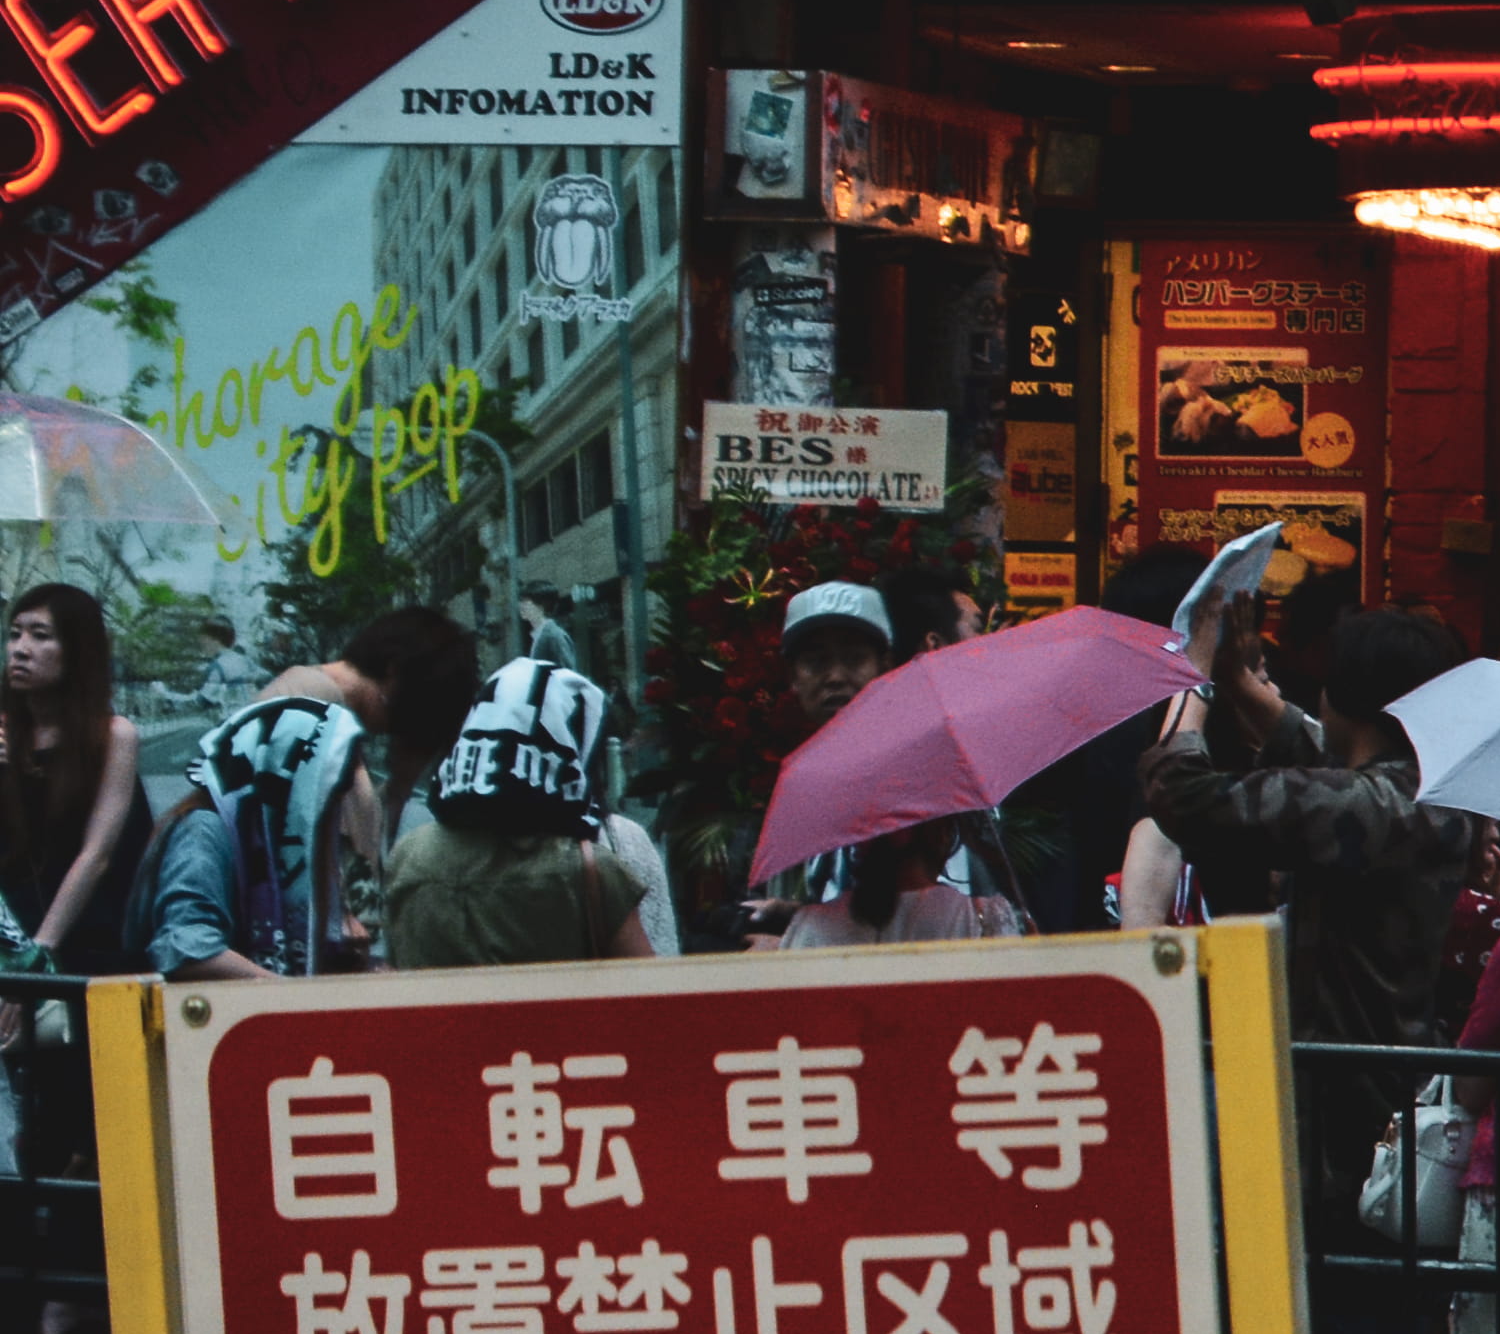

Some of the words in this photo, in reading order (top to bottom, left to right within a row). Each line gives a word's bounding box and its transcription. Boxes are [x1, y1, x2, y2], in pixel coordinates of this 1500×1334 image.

[548, 52, 655, 80] LD&K
[401, 88, 655, 117] INFOMATION
[1162, 279, 1366, 306] ハンバーグステーキ
[1285, 308, 1366, 333] 専門店
[371, 364, 484, 544] pop
[715, 434, 835, 465] BES
[713, 466, 778, 496] SPICY
[786, 468, 923, 502] CHOCOLATE
[265, 1022, 1109, 1219] 自転車等
